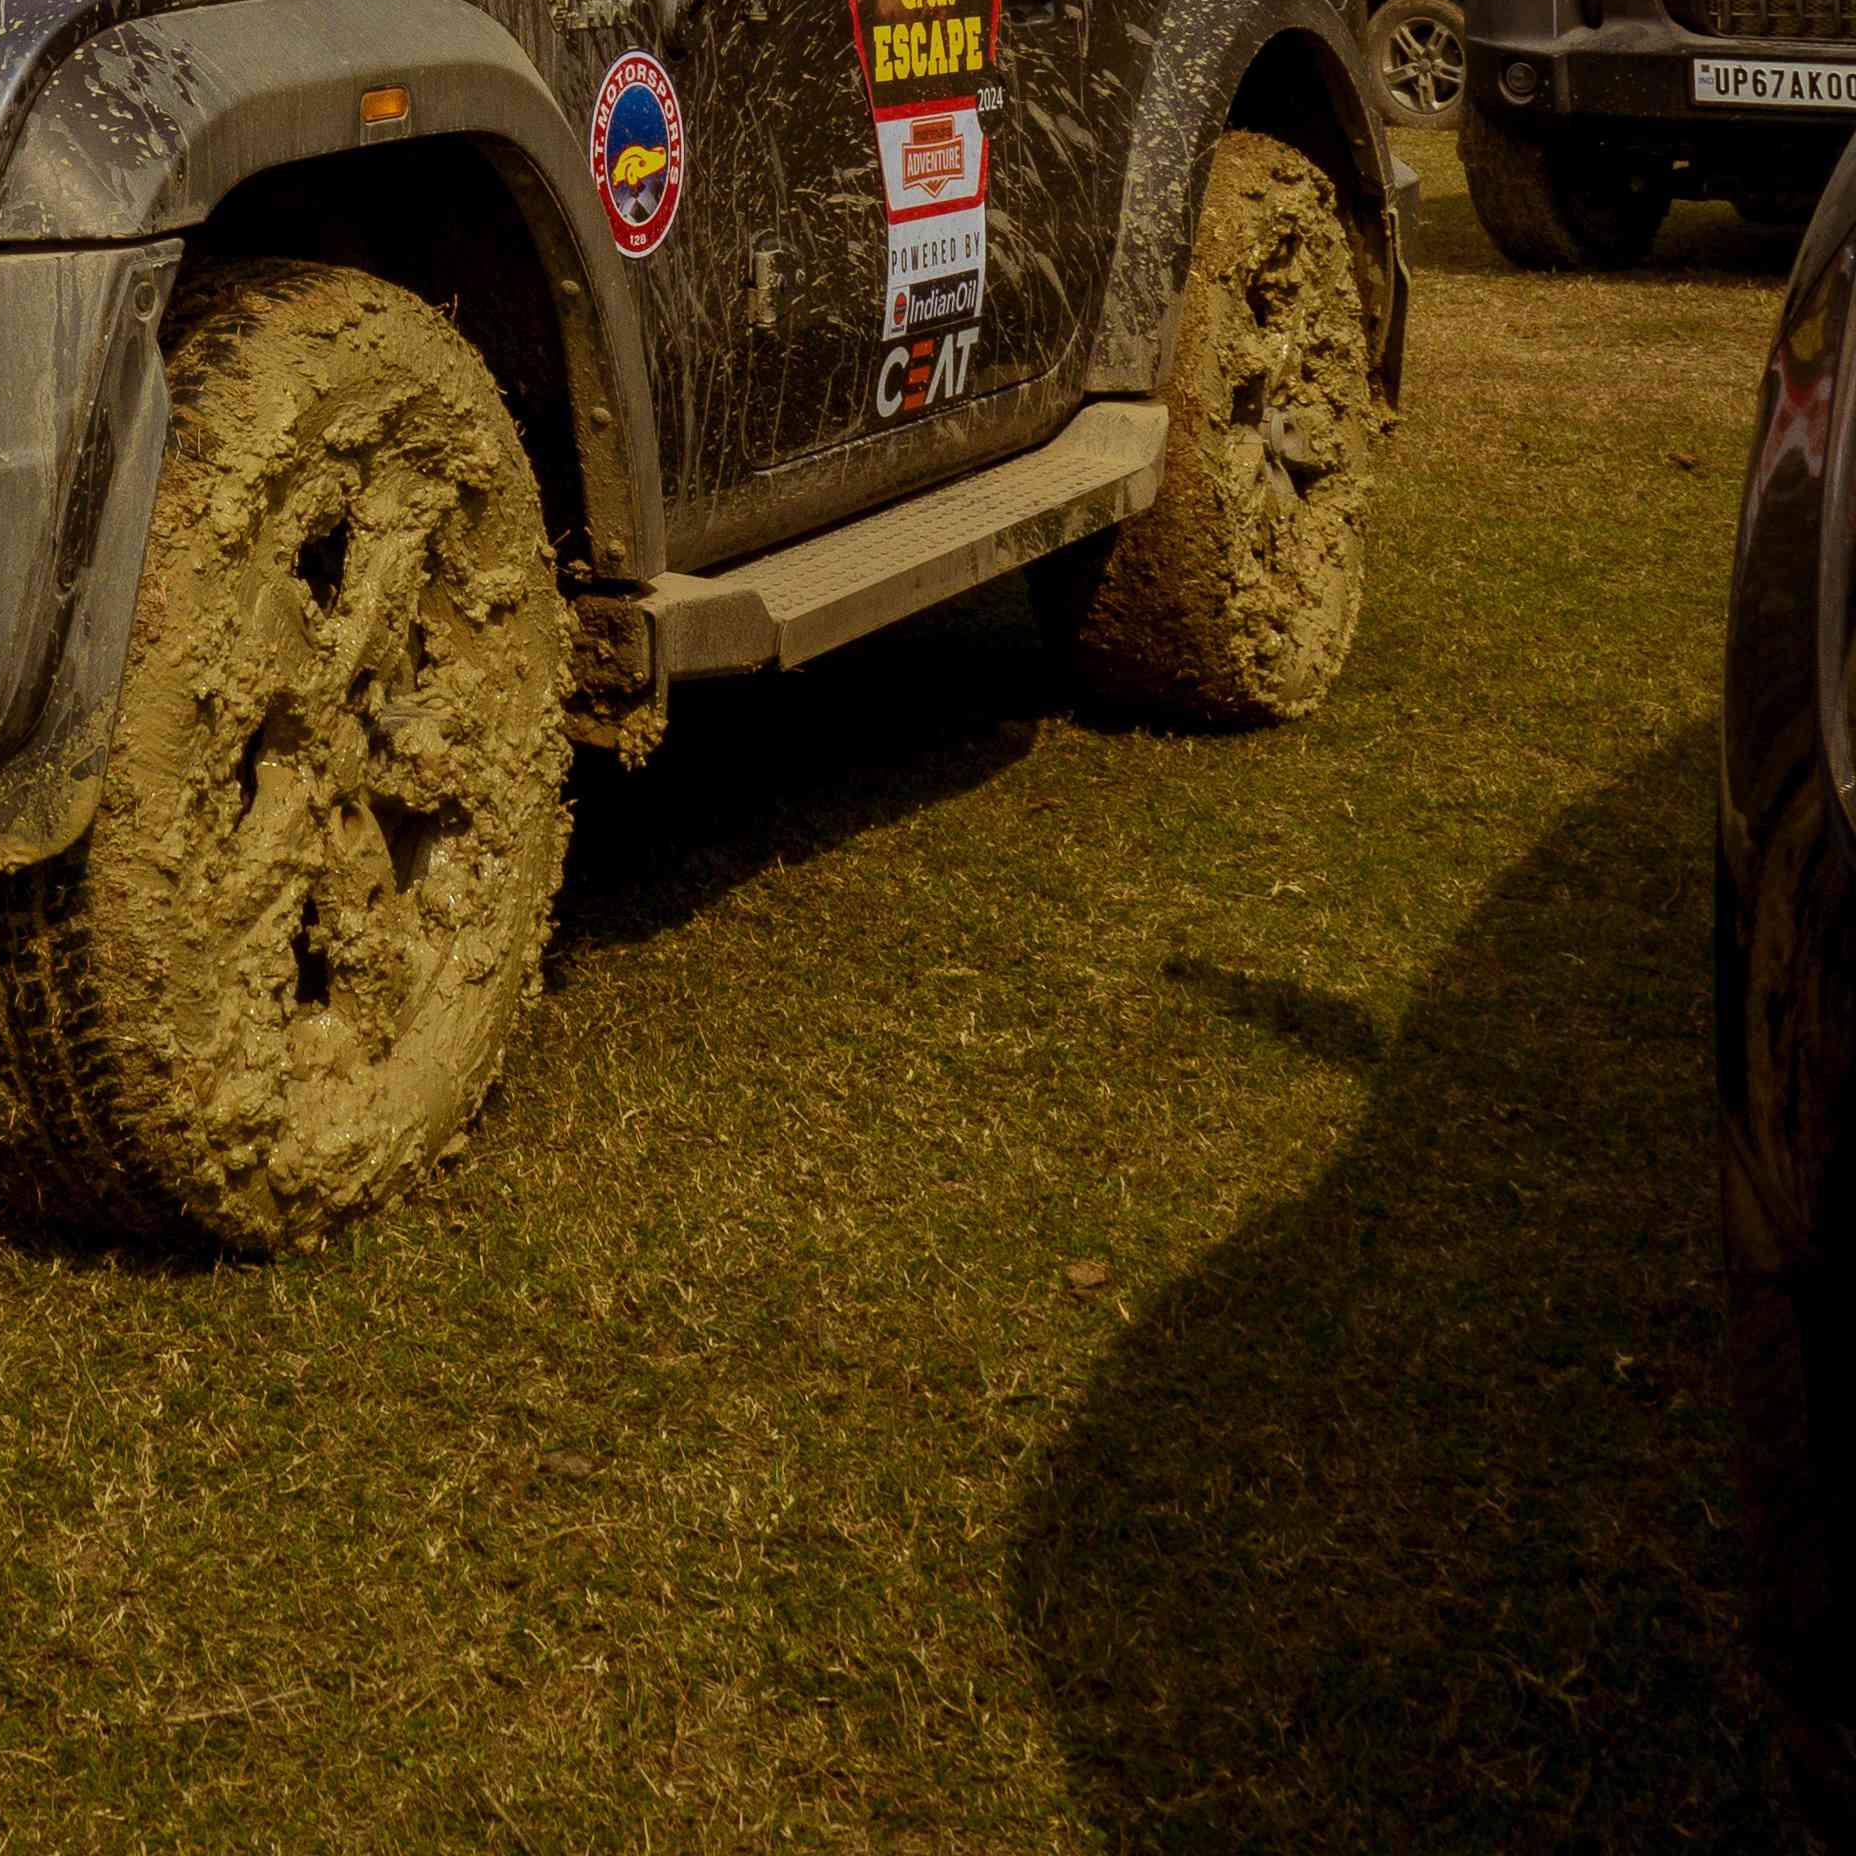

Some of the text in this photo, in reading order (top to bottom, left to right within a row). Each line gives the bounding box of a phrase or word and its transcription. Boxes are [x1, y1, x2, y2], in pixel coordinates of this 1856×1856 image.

[874, 16, 983, 83] ESCAPE
[977, 87, 1004, 113] 2024
[907, 145, 961, 177] ADVENTURE
[891, 231, 981, 276] POWERED BY
[909, 279, 977, 324] IndianOil
[876, 327, 980, 418] CEAT
